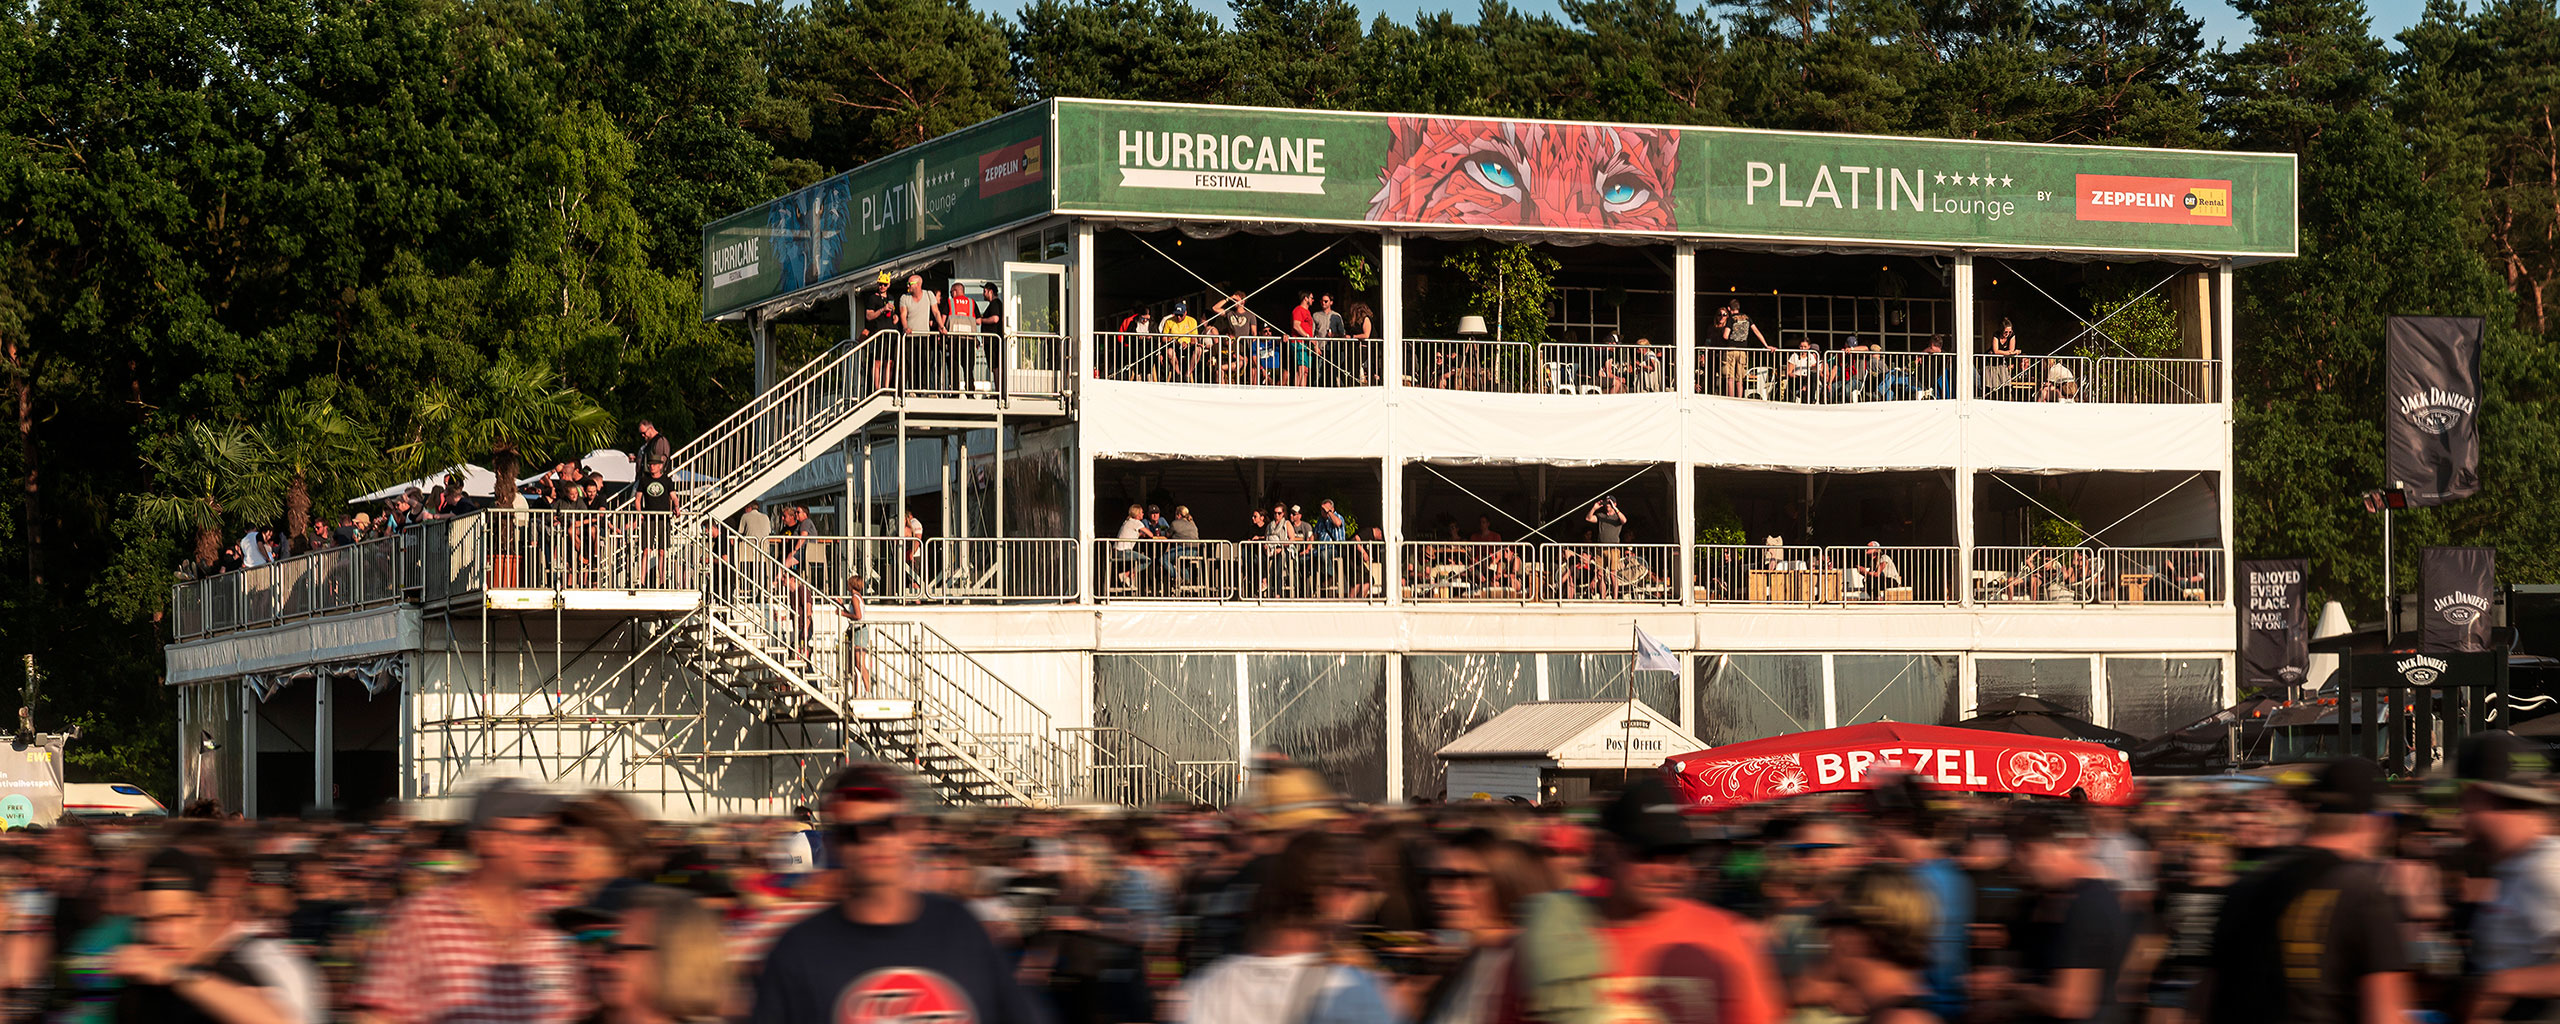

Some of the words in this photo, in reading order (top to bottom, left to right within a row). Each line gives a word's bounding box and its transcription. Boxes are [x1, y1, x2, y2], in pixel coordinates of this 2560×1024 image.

[1118, 129, 1326, 174] HURRICANE
[984, 159, 1019, 182] ZEPPELIN
[963, 177, 971, 188] BY
[1195, 174, 1251, 189] FESTIVAL
[1746, 161, 1924, 212] PLATIN
[925, 192, 957, 214] Lounge
[2037, 191, 2052, 201] BY
[2091, 190, 2174, 208] ZEPPELIN
[2199, 198, 2224, 207] Rental
[862, 176, 923, 236] PLATIN
[1933, 192, 2015, 221] Lounge
[712, 236, 759, 275] HURRICANE
[2400, 391, 2429, 415] JACK
[2250, 571, 2301, 584] ENJOYED
[2250, 584, 2287, 597] EVERY
[2250, 597, 2290, 610] PLACE.
[2433, 595, 2455, 612] JACK
[2455, 590, 2489, 611] DANIEL'S
[2250, 612, 2282, 622] MADE
[2250, 621, 2263, 630] IN
[2396, 657, 2417, 674] JACK
[2416, 654, 2448, 673] DANIEL'S
[1633, 738, 1662, 750] OFFICE
[27, 752, 52, 762] EWE
[1815, 747, 1988, 786] BREZEL
